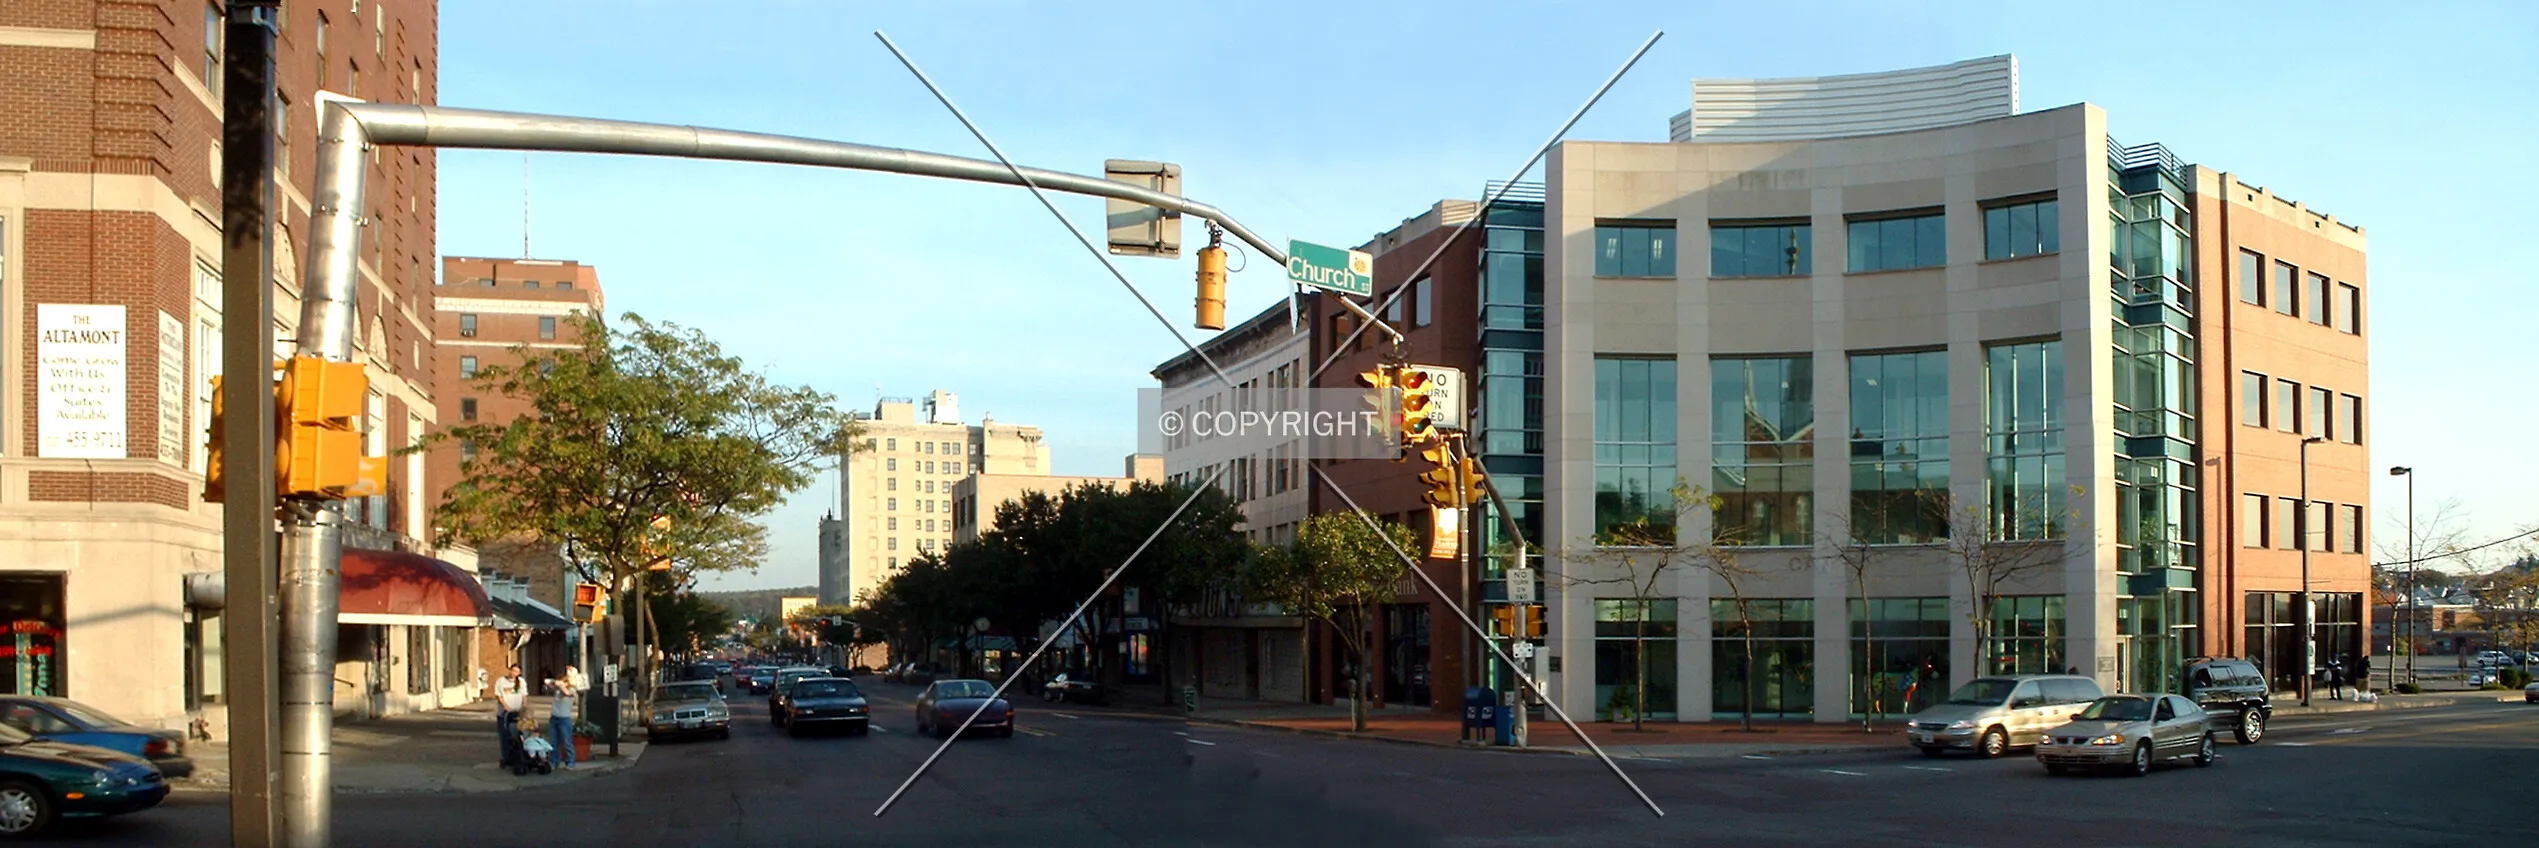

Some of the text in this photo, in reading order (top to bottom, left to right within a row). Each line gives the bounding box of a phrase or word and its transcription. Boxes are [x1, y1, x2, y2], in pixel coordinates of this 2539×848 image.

[1288, 256, 1355, 290] Church
[72, 314, 91, 325] THE
[42, 329, 120, 344] ALTAMONT
[50, 368, 83, 379] With
[50, 383, 94, 394] Office
[1427, 388, 1448, 398] URN
[63, 397, 102, 407] Suites
[56, 409, 110, 420] Available
[1513, 571, 1528, 579] NO
